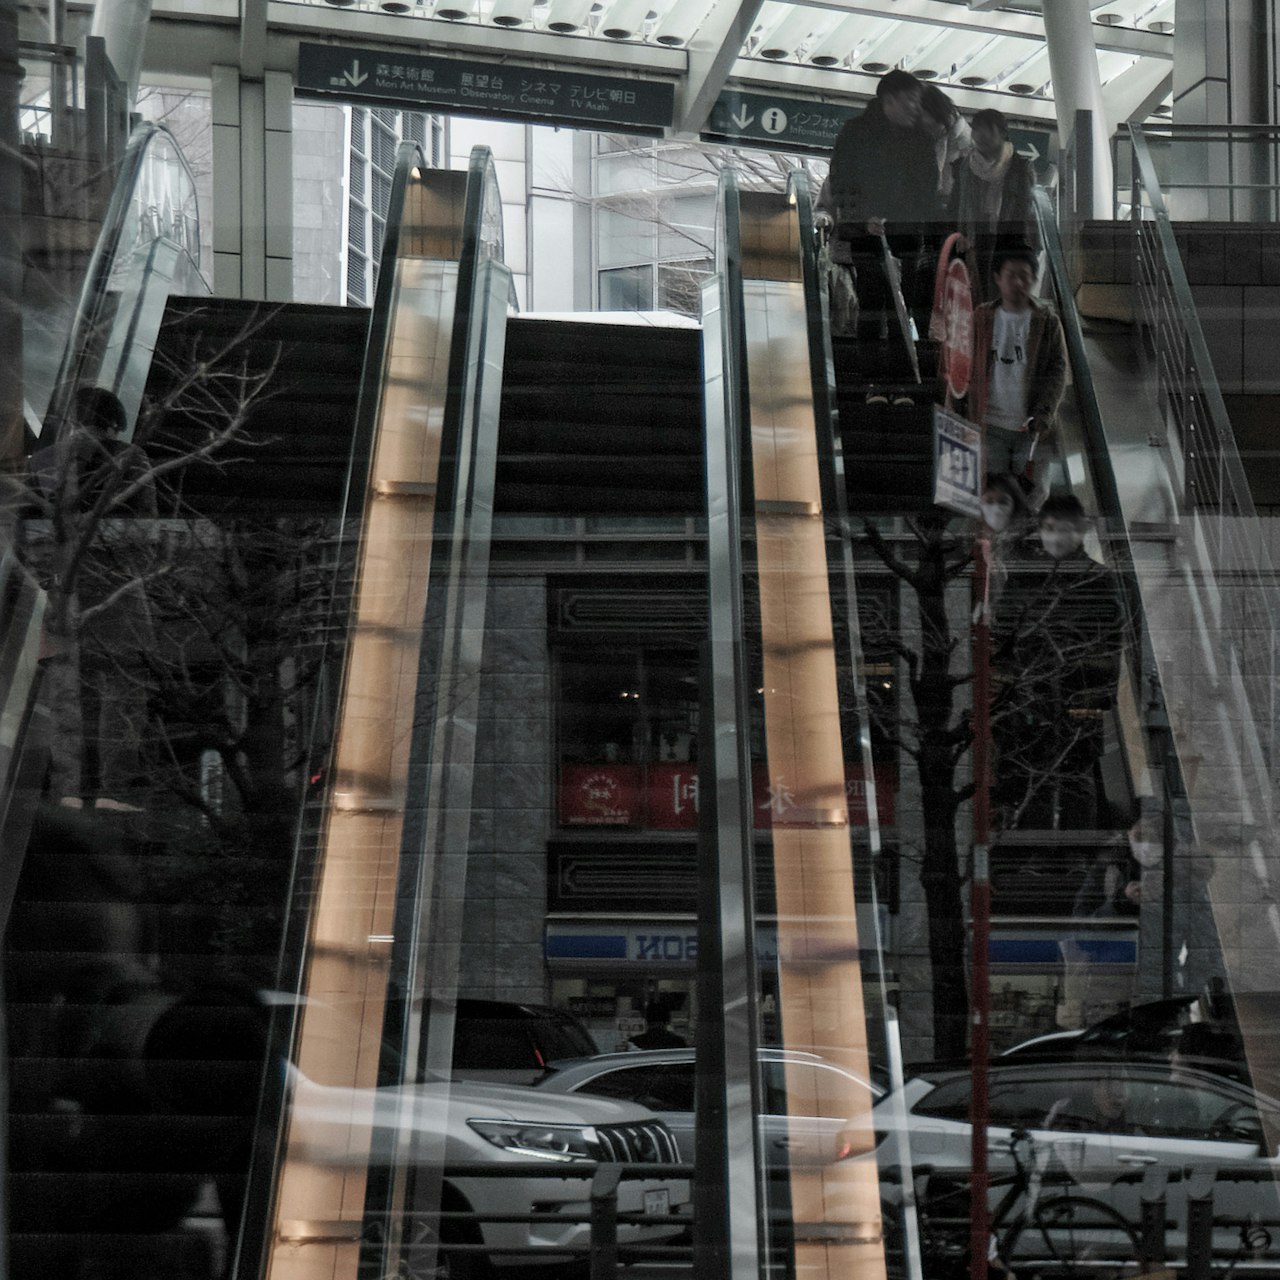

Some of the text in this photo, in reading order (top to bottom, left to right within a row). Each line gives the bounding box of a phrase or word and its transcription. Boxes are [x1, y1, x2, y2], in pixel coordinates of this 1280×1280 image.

[375, 63, 637, 105] 森美術館 展望台 シネマ テレビ朝日
[400, 80, 415, 90] Art
[417, 83, 457, 95] Museum
[460, 88, 515, 104] Observatory
[519, 93, 555, 106] Cinema
[570, 98, 583, 109] TV
[586, 101, 610, 112] Asahi
